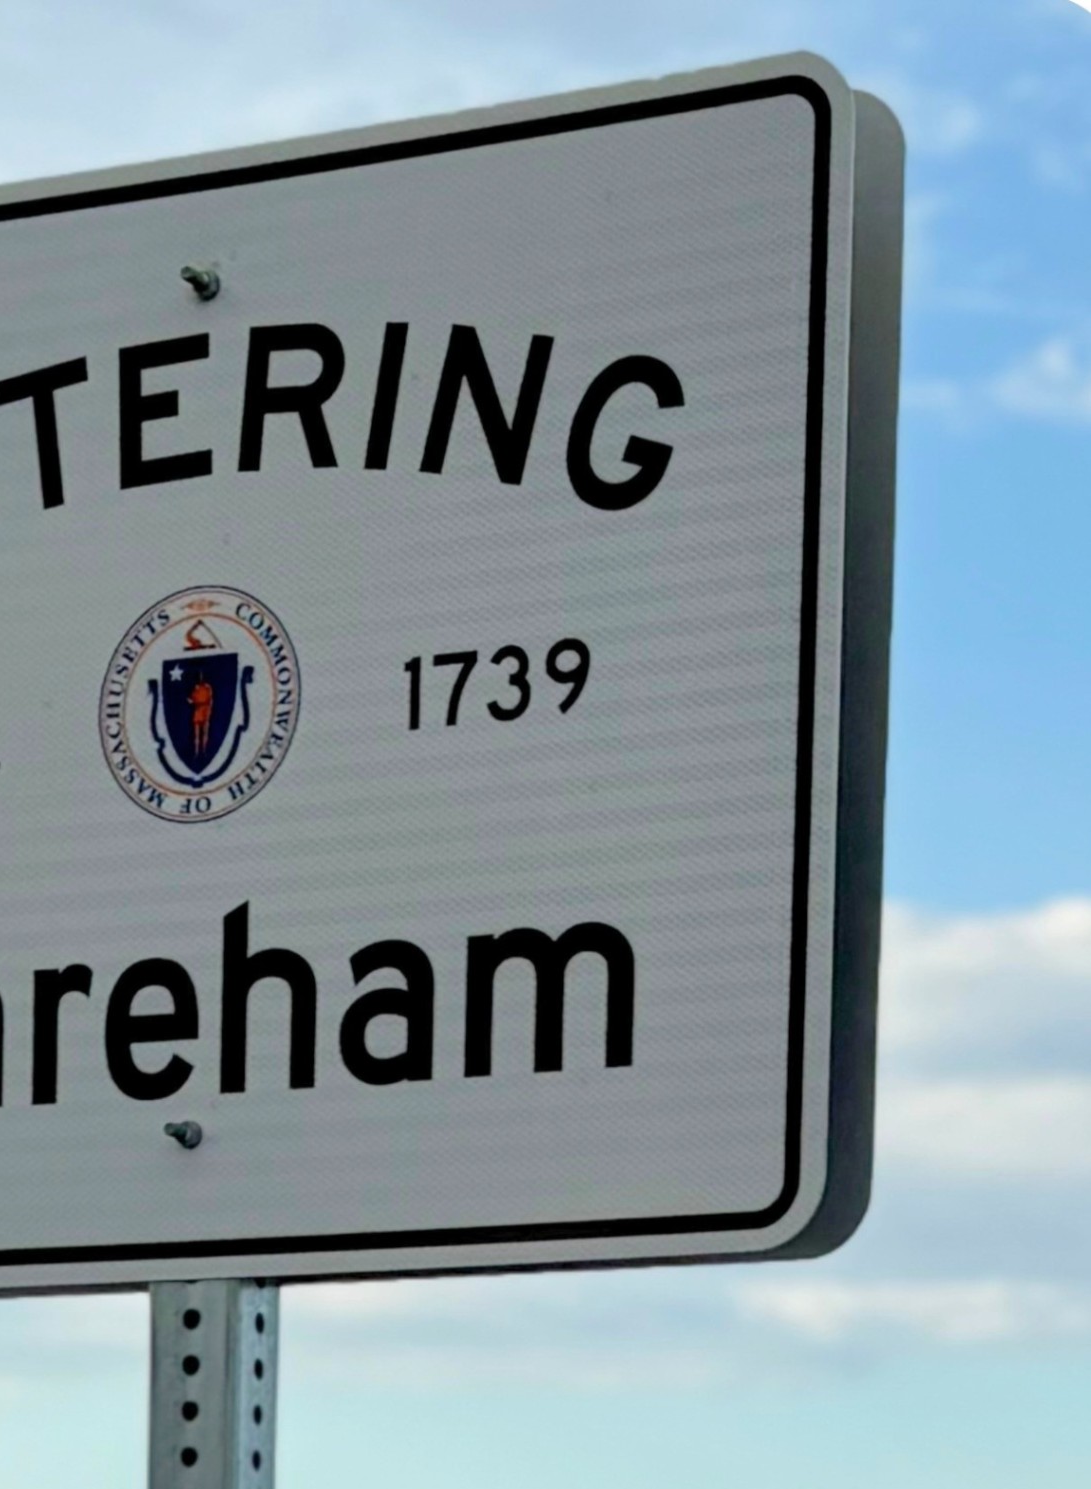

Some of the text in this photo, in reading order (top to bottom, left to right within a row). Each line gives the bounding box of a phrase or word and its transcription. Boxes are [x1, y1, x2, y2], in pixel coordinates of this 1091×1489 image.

[105, 602, 293, 814] COMMONWEALTH OF MASSACHUSETTS
[402, 637, 591, 731] 1739
